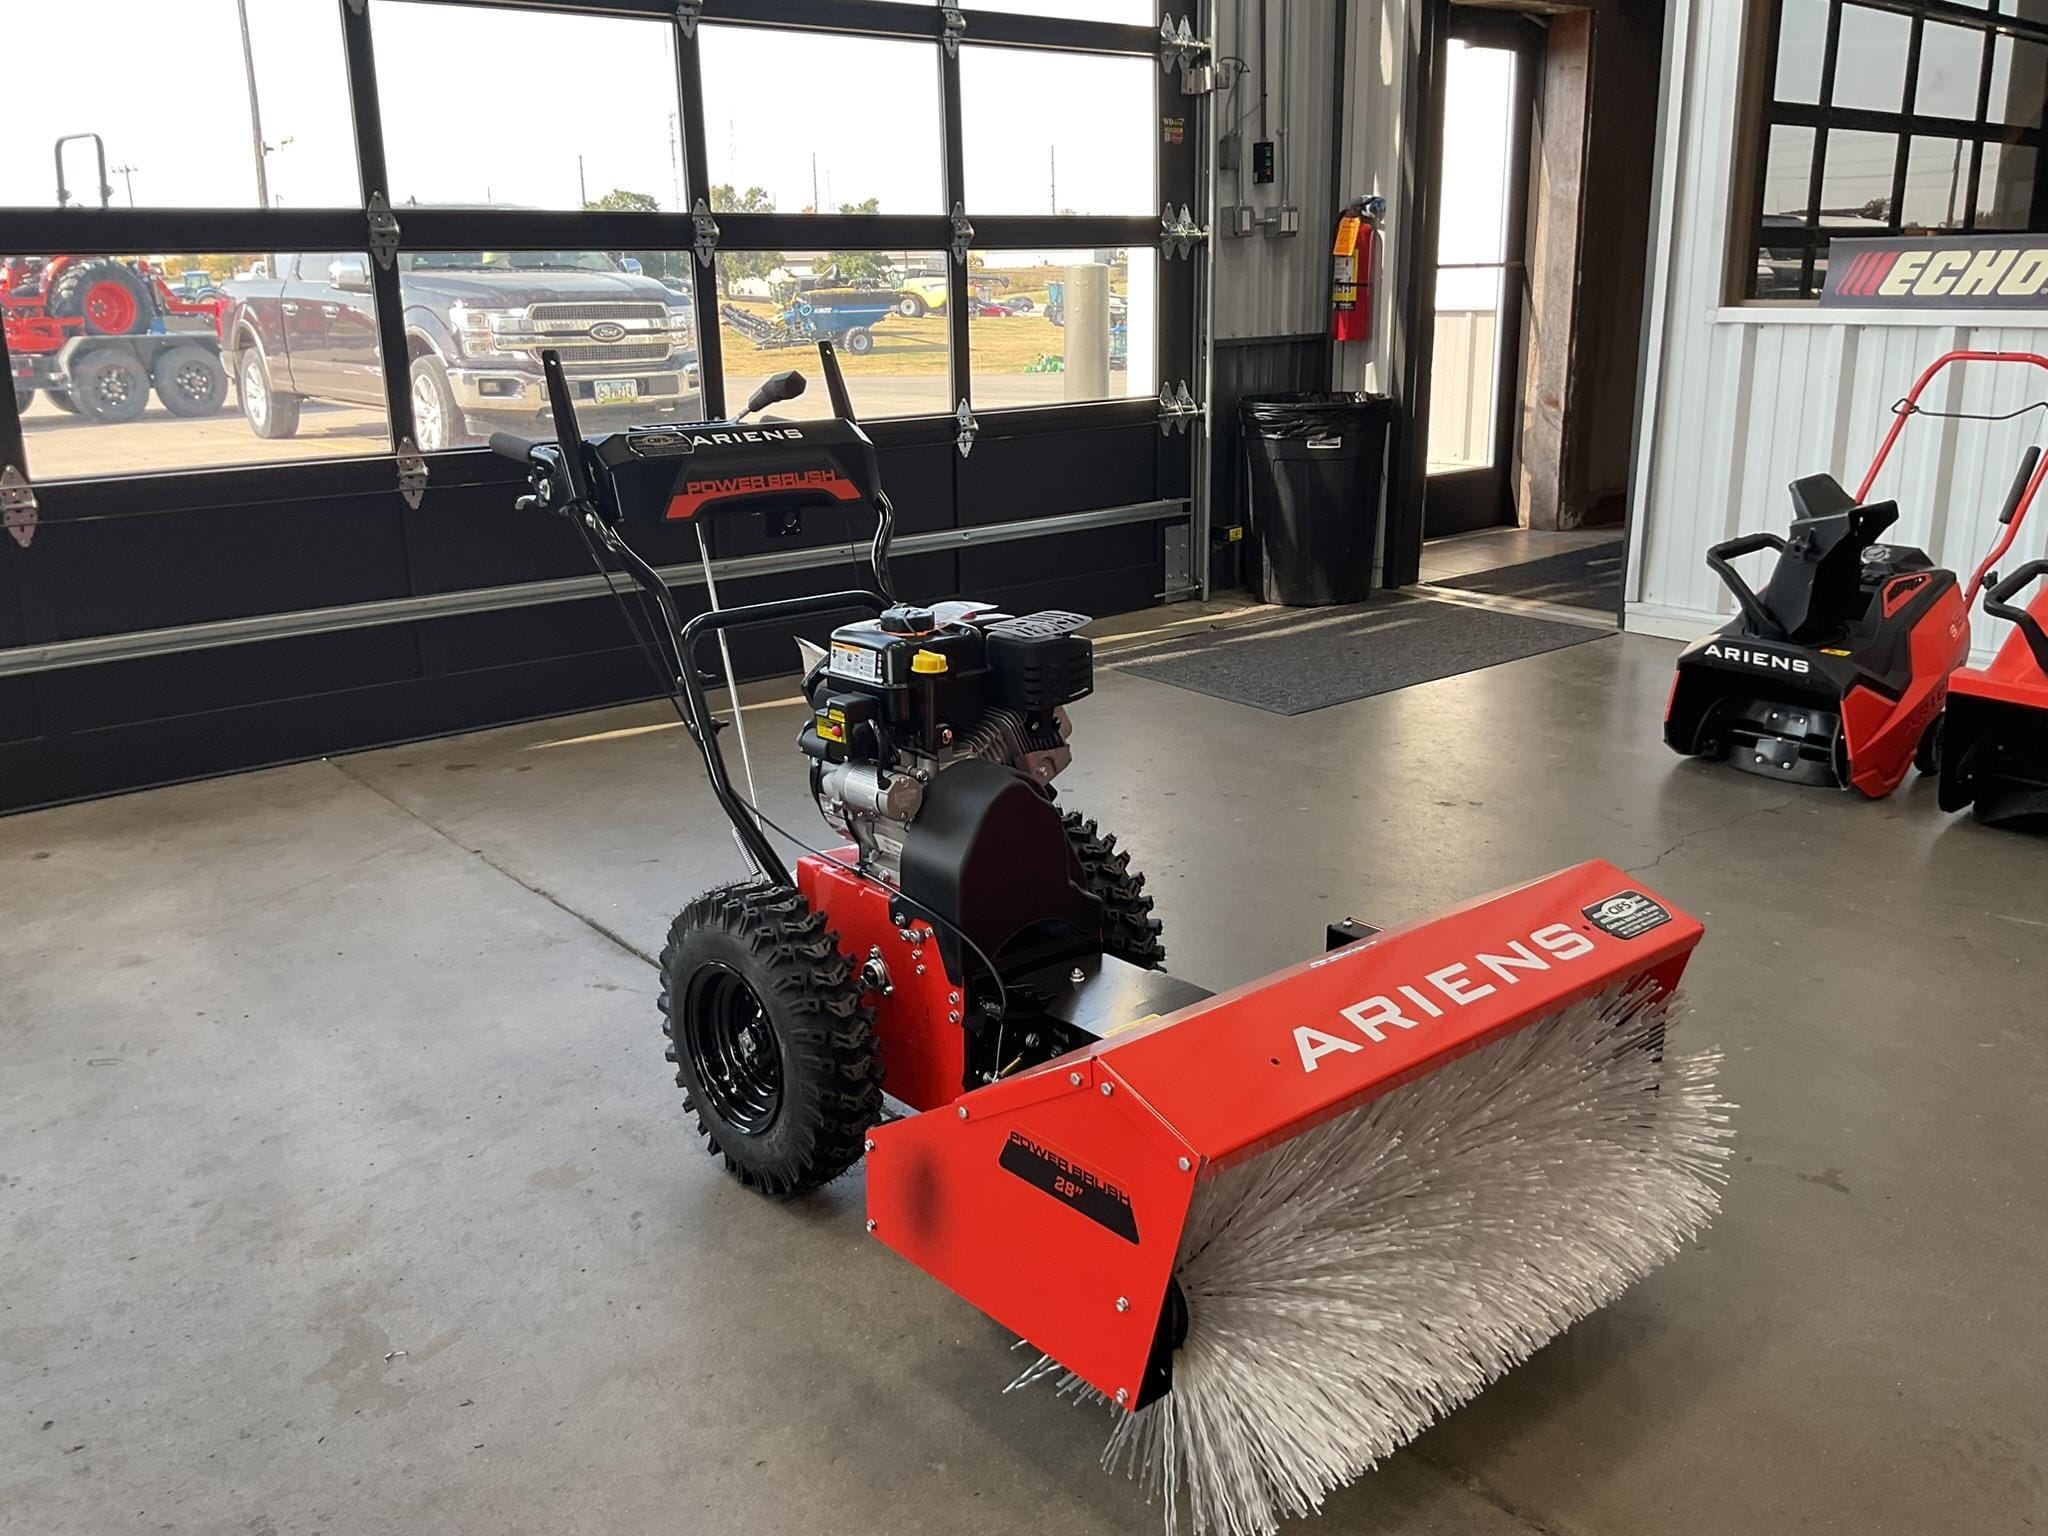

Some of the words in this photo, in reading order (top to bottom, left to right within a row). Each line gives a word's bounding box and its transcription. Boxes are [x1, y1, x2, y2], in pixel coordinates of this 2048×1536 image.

[1878, 249, 2048, 296] ECHO
[693, 429, 804, 447] ARIENS
[686, 475, 765, 495] POWER
[767, 469, 837, 489] BRUSH
[1704, 644, 1810, 674] ARIENS
[1607, 900, 1633, 915] CIFS
[1292, 923, 1595, 1074] ARIENS
[1010, 1130, 1071, 1174] POWER
[1071, 1163, 1132, 1207] BRUSH
